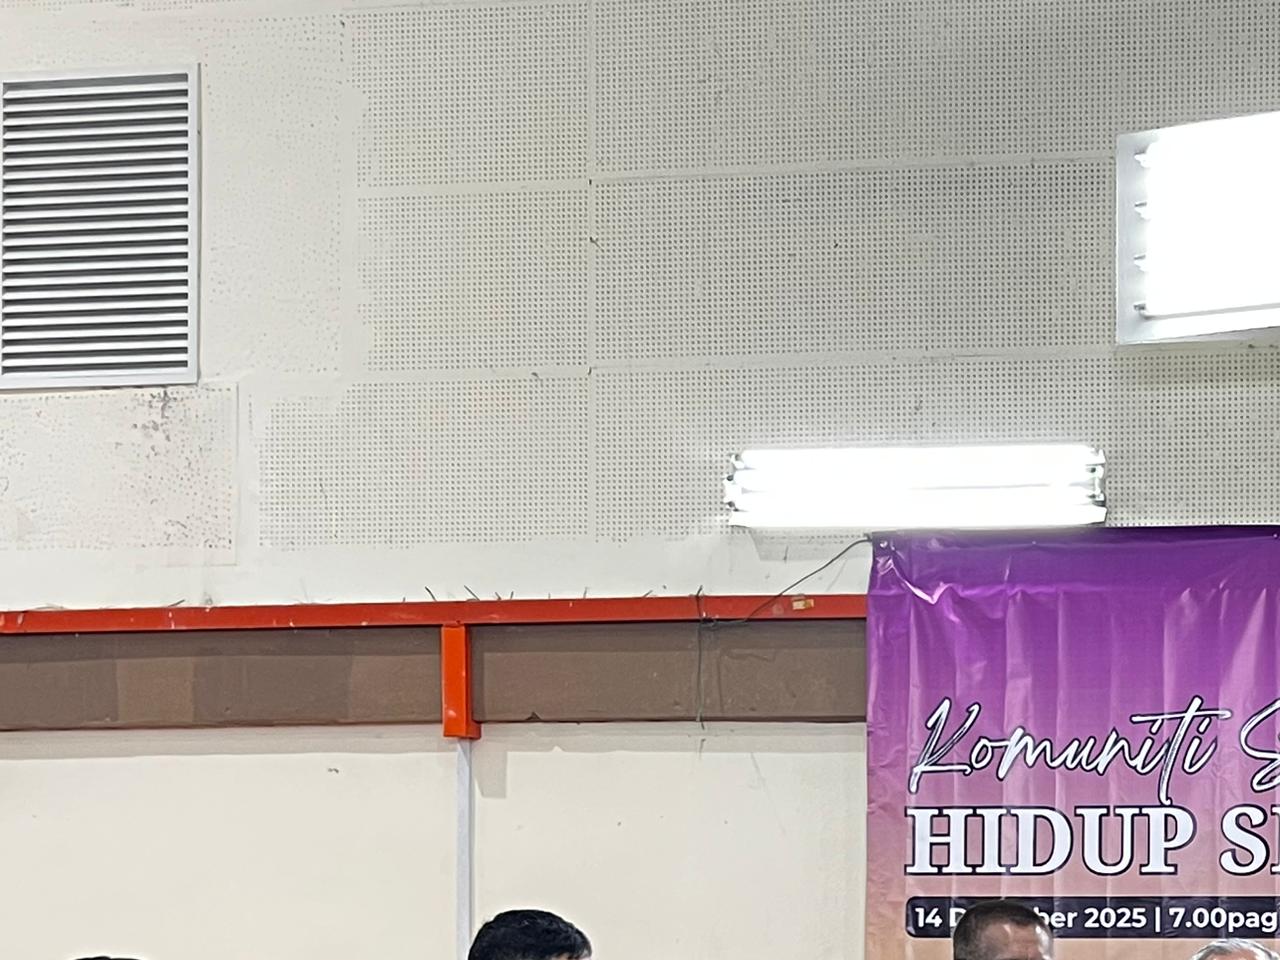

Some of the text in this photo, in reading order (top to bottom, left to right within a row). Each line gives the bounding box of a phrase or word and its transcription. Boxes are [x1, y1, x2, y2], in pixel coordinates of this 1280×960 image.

[908, 695, 1232, 805] Komuniti
[905, 804, 1197, 875] HIDUP
[915, 907, 942, 928] 14
[949, 907, 1078, 928] Dber
[1084, 907, 1146, 928] 2025
